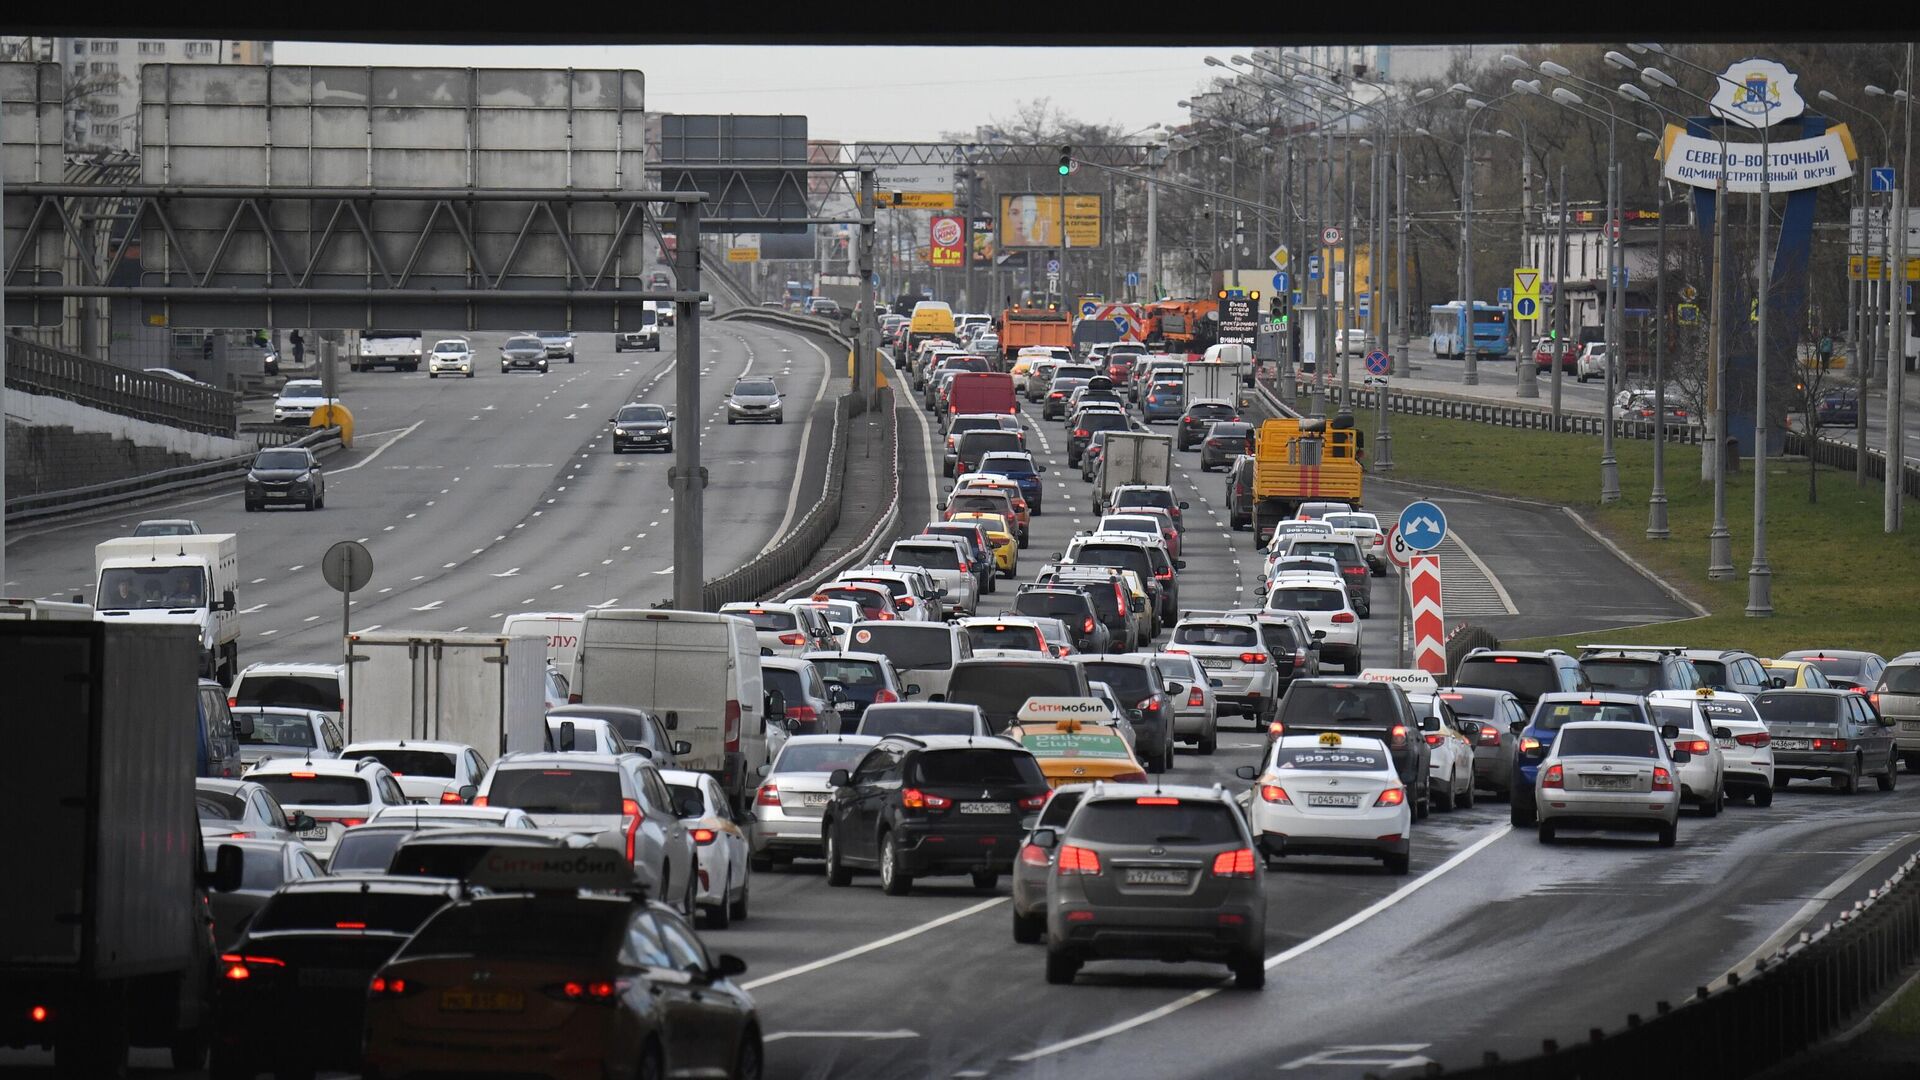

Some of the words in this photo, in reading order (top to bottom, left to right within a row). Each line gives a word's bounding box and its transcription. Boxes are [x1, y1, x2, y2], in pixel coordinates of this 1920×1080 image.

[1803, 165, 1837, 180] ОКРУГ
[1326, 231, 1337, 239] 80
[1264, 323, 1286, 332] СТОП
[1541, 344, 1568, 353] СТП
[1395, 534, 1414, 553] 8
[1363, 672, 1429, 683] Ситимобил
[1028, 702, 1103, 713] Ситимобил
[1035, 734, 1111, 744] Delivery
[1036, 740, 1080, 748] Club
[487, 855, 617, 874] Ситимобил
